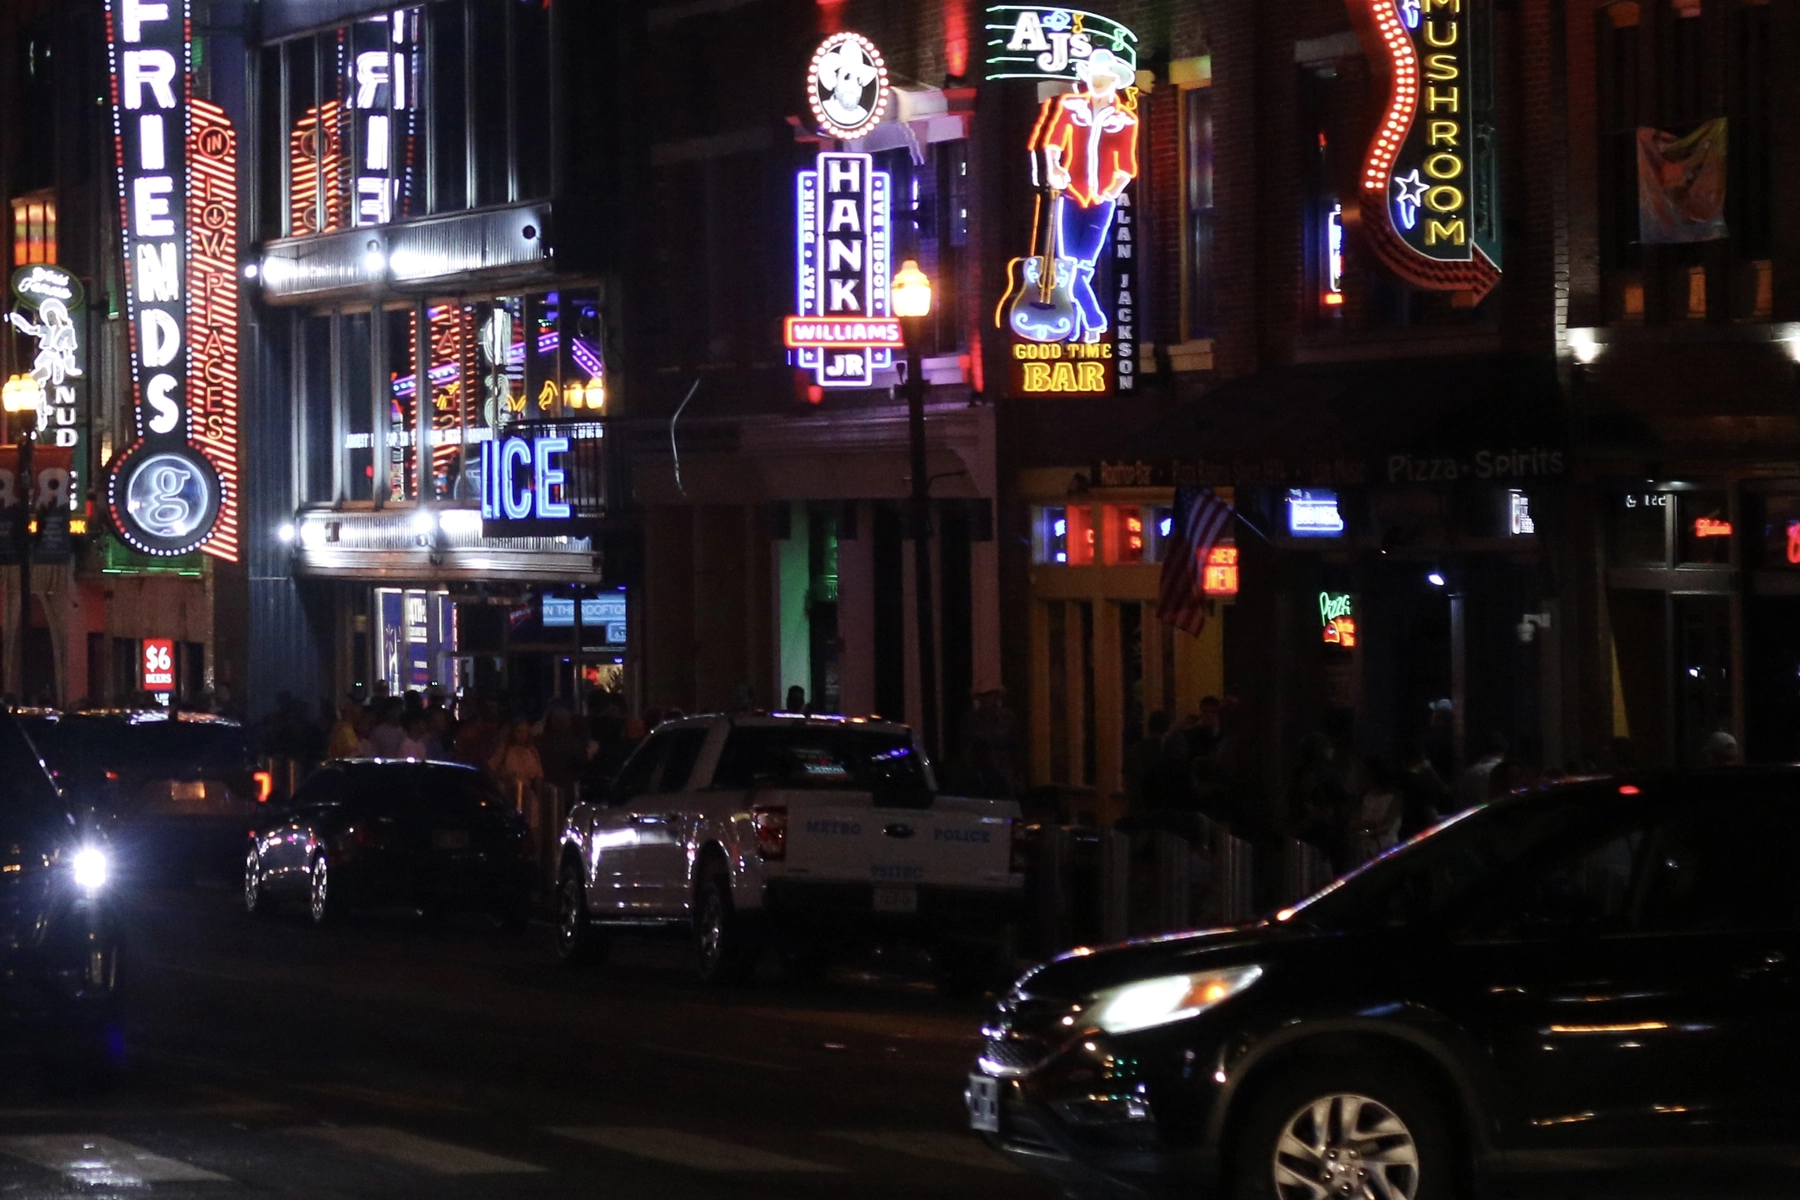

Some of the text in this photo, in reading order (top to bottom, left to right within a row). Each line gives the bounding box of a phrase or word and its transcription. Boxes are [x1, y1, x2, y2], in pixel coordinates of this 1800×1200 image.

[803, 188, 816, 244] DRINK
[827, 159, 862, 312] HANK
[1116, 192, 1135, 392] ALAN JACKSON
[793, 322, 899, 343] WILLIAMS
[204, 272, 226, 440] PLACES
[825, 352, 865, 379] JR
[1067, 343, 1112, 359] TIME
[1023, 363, 1106, 392] BAR
[1388, 448, 1565, 483] Pizza Spirits
[146, 644, 171, 673] $6
[807, 821, 991, 843] METRO POLICE
